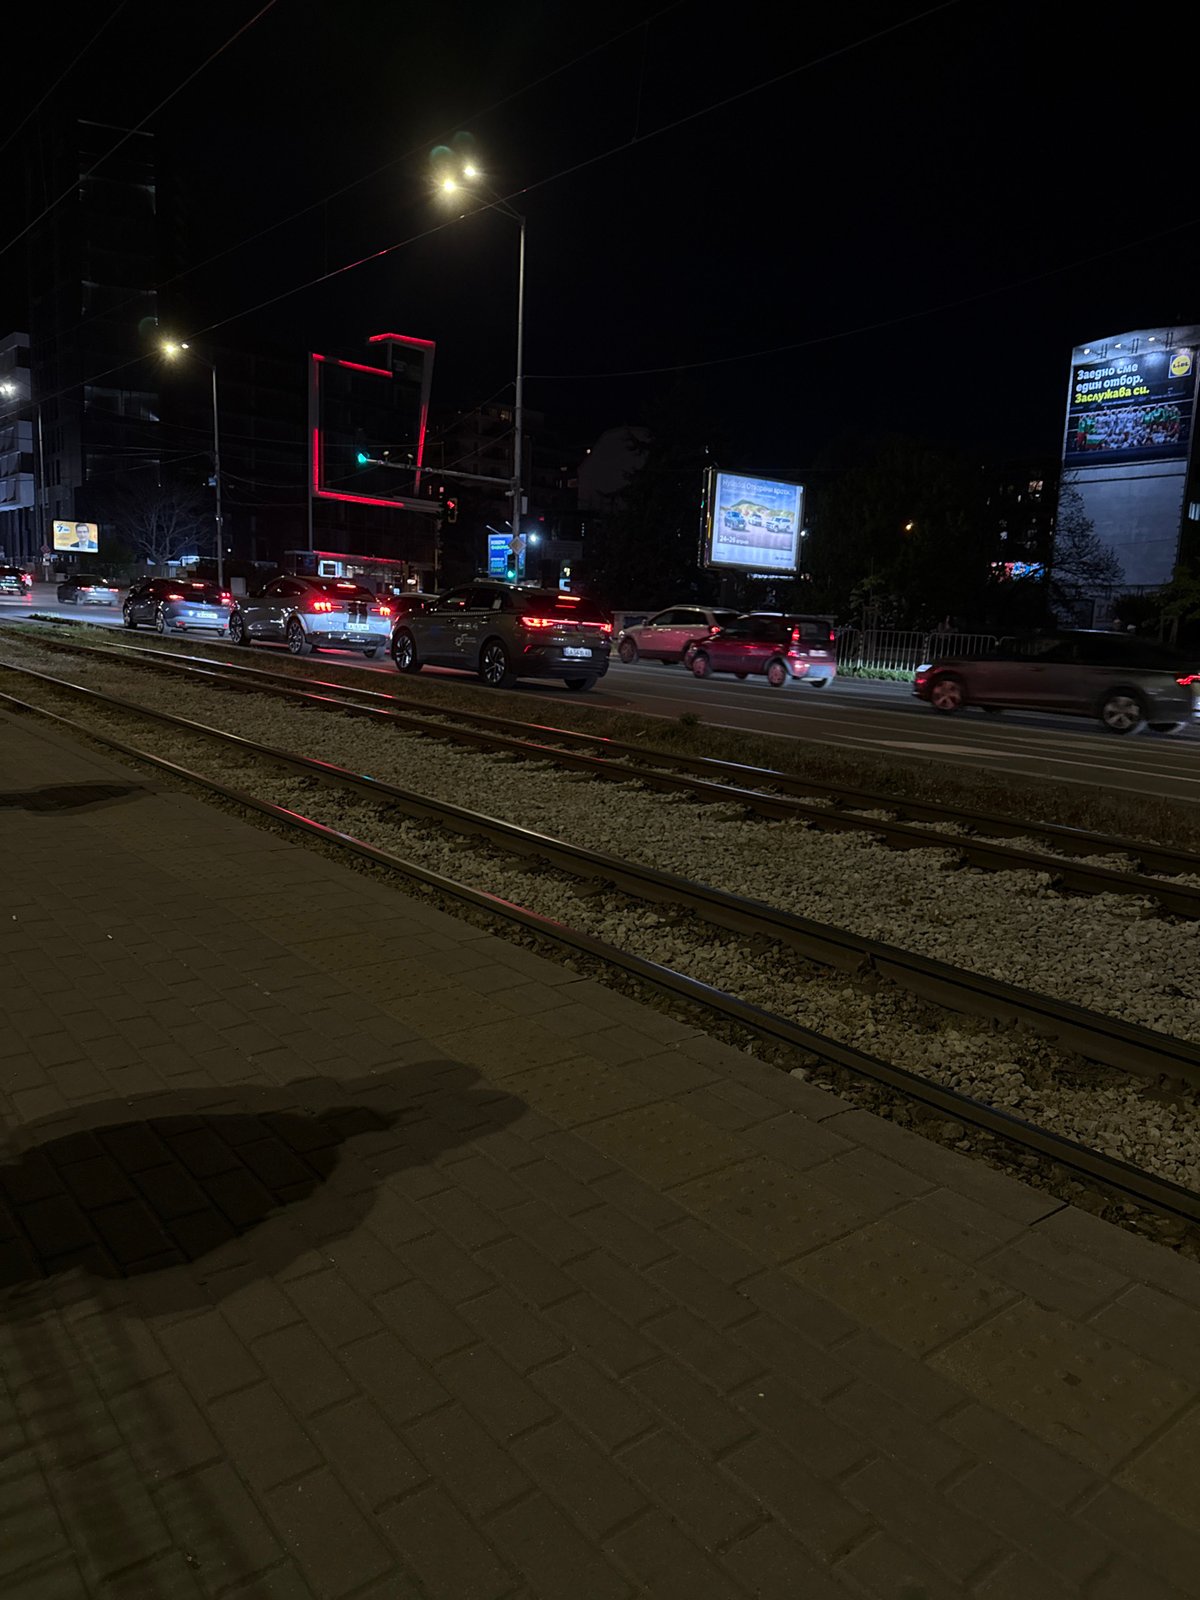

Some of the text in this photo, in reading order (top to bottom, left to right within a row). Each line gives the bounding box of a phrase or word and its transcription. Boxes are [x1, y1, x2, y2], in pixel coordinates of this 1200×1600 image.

[1077, 363, 1138, 380] Заедно сме
[1076, 374, 1143, 394] един отбор.
[1074, 386, 1150, 403] Заслужава си.
